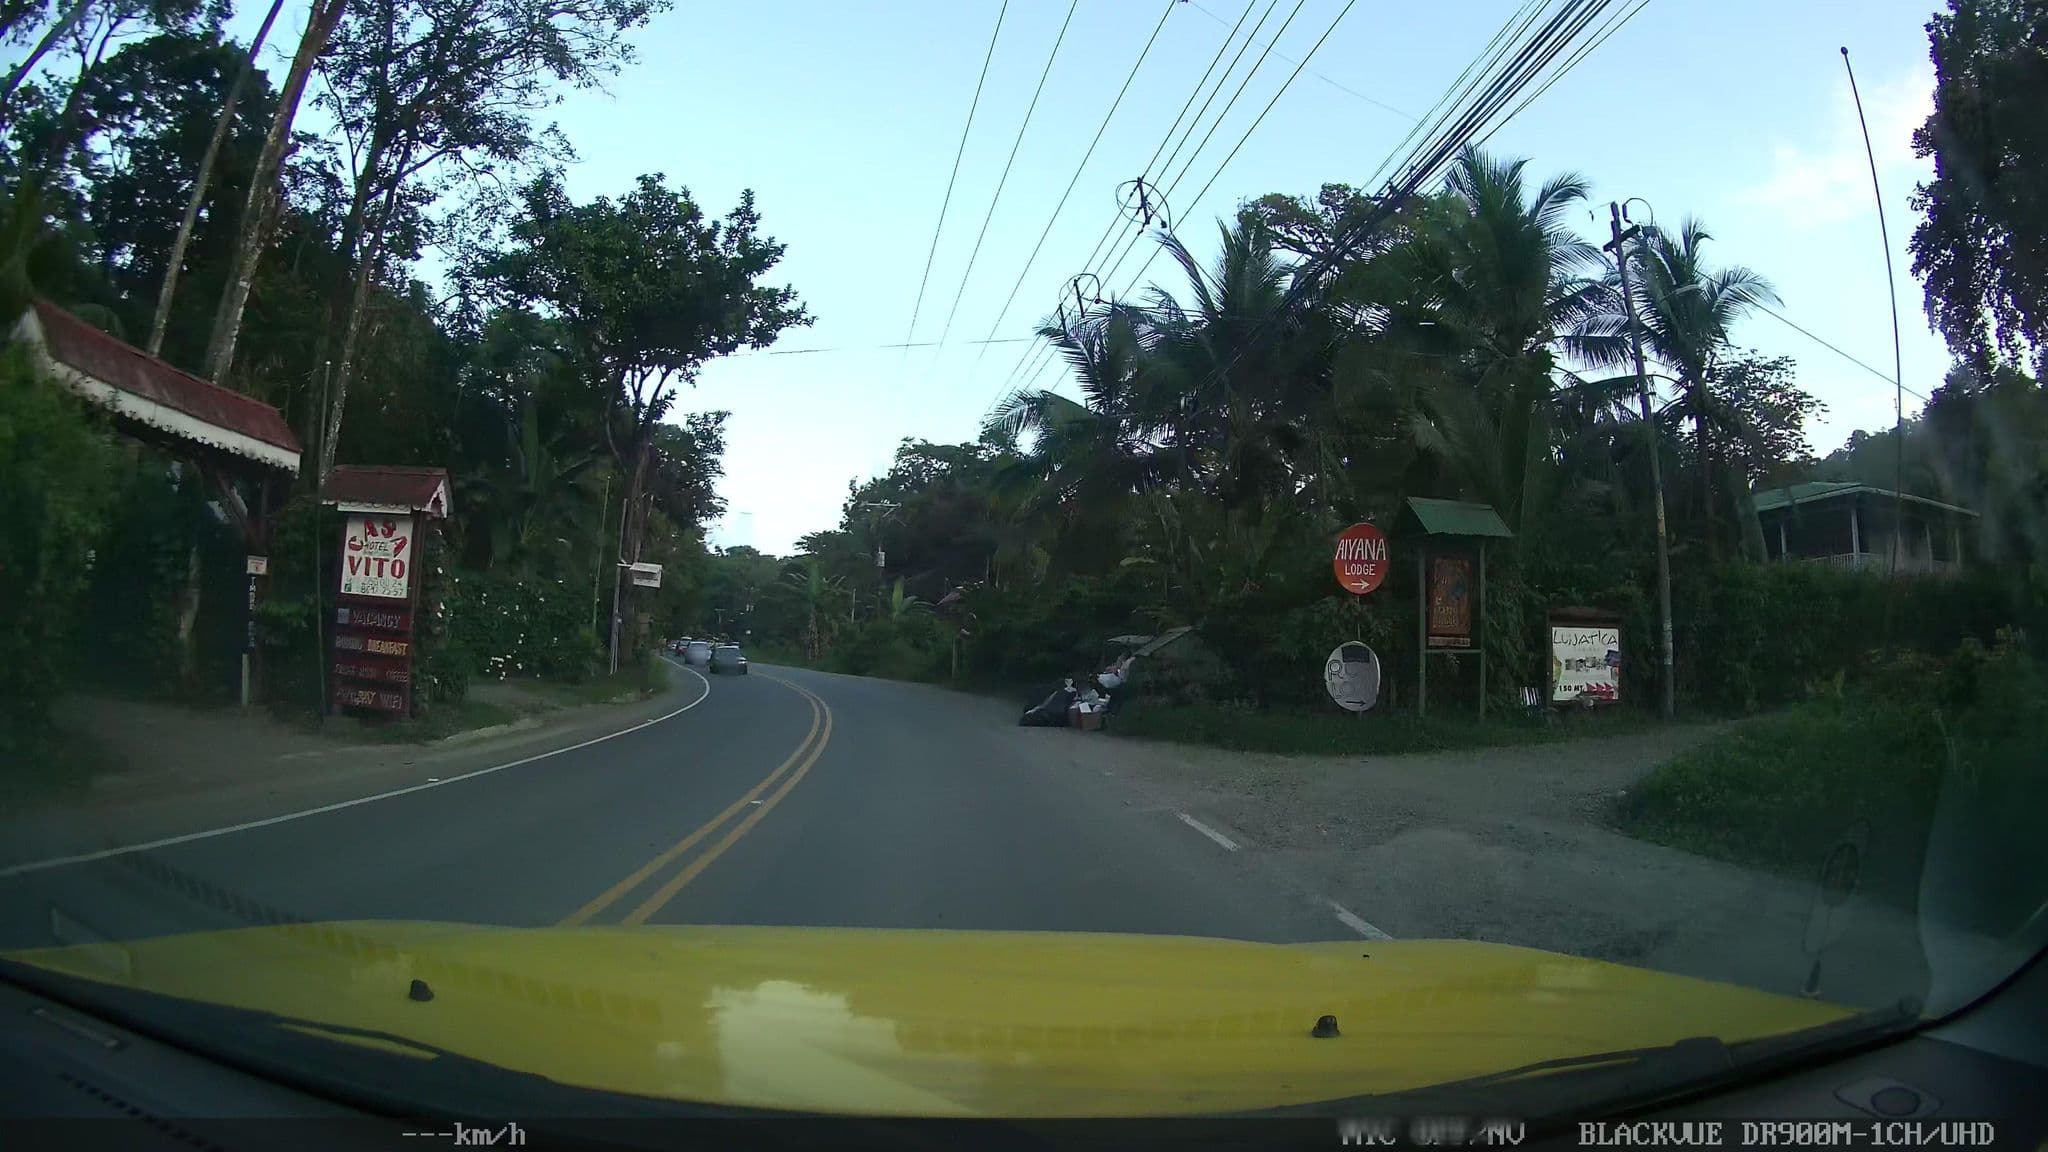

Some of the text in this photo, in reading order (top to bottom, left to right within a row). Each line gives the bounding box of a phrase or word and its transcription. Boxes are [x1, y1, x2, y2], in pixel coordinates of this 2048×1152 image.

[348, 519, 408, 558] CASA
[1335, 538, 1386, 561] AIYANA
[348, 555, 406, 579] VITO
[1344, 563, 1376, 576] LODGE
